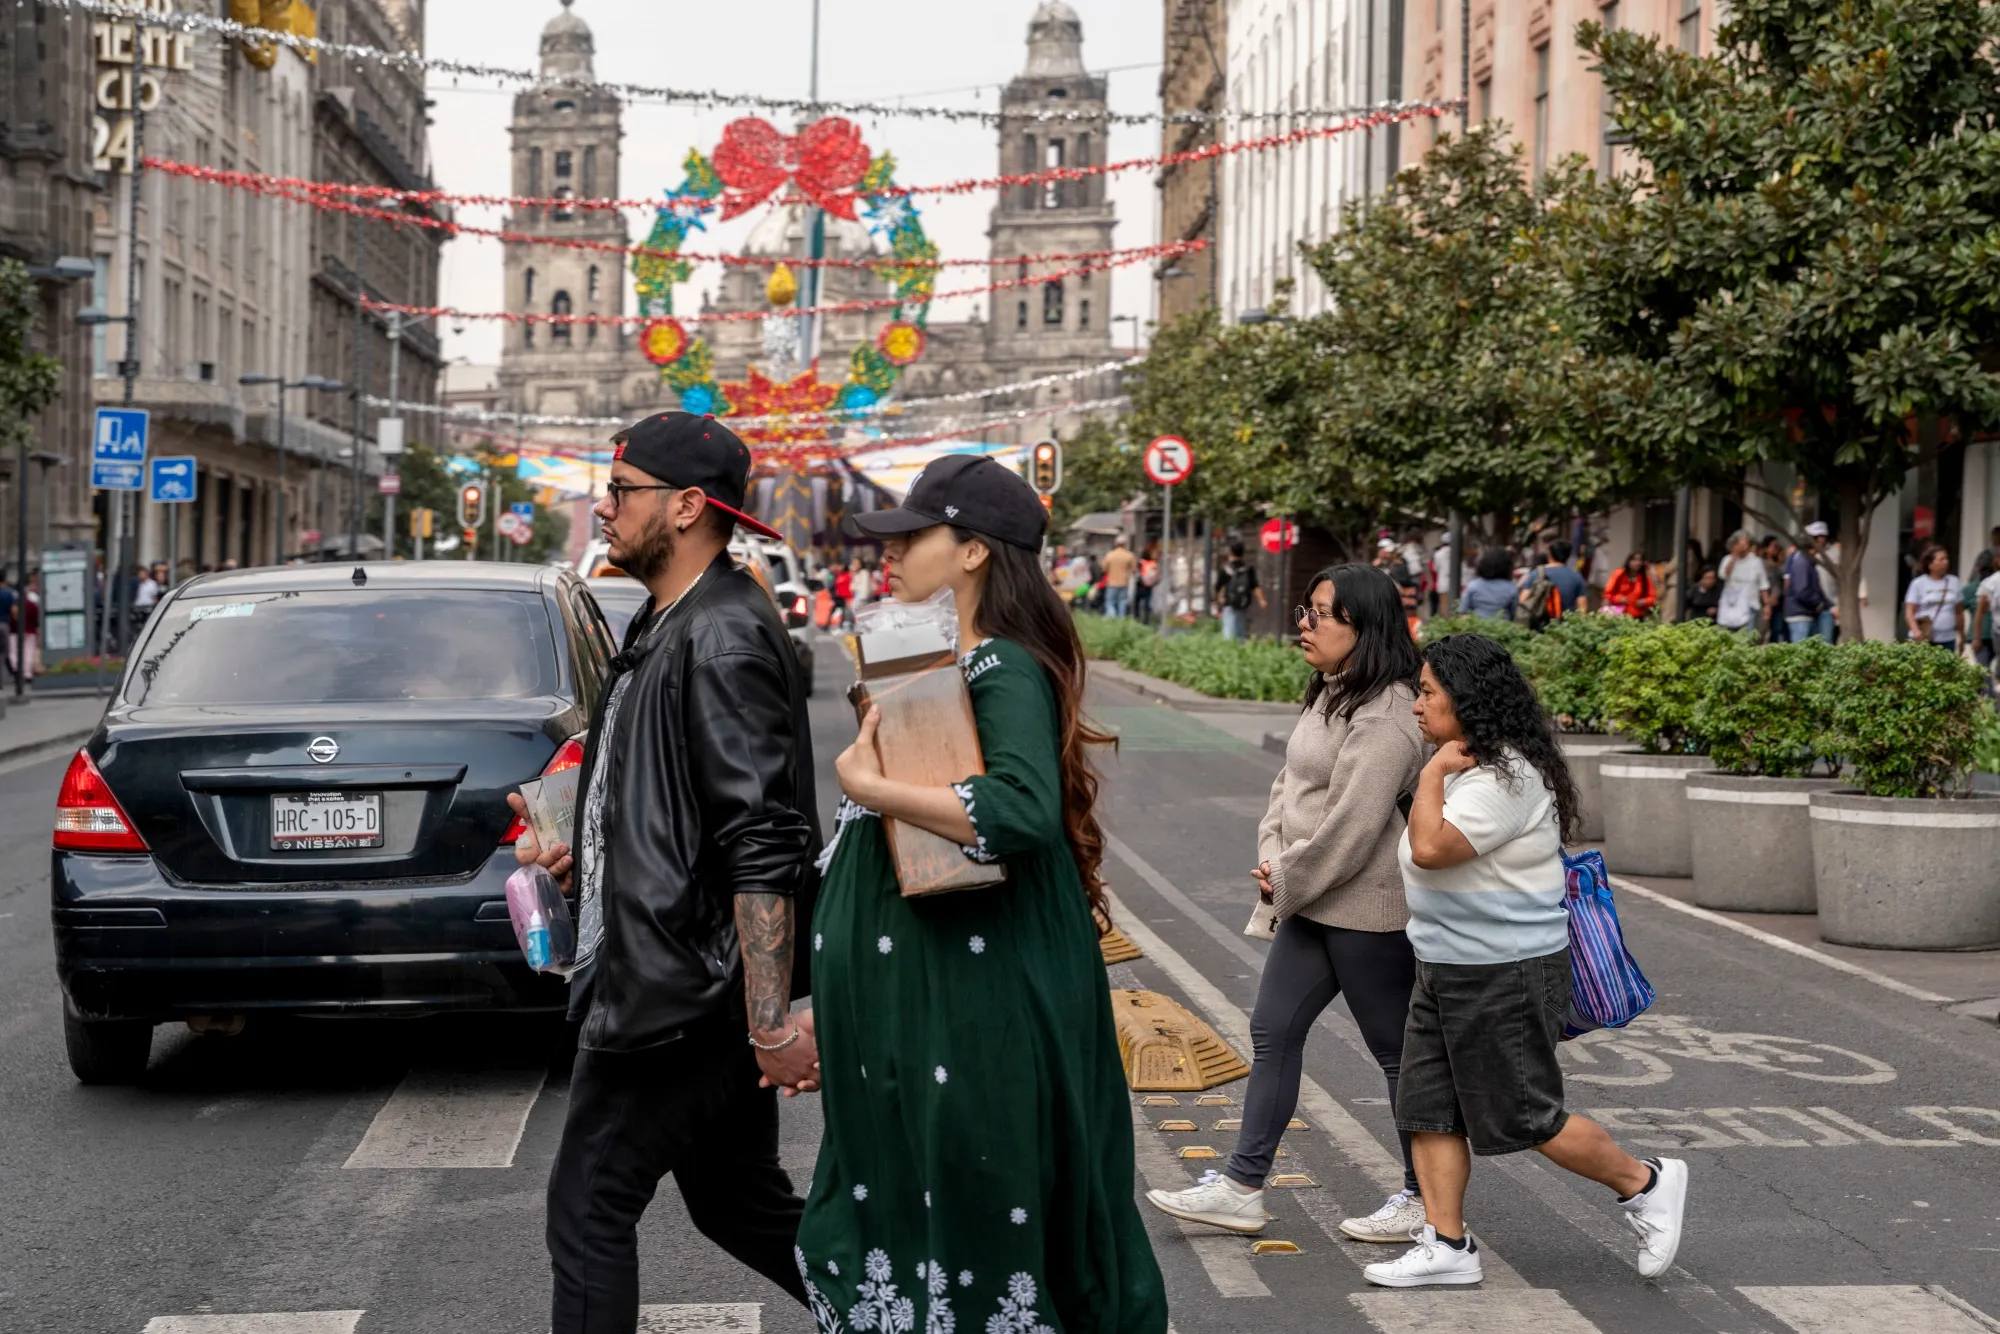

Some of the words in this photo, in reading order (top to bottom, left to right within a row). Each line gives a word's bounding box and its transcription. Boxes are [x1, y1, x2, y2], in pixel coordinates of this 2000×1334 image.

[1160, 446, 1178, 473] E
[276, 807, 376, 832] HRC-105-D
[296, 838, 356, 849] NISSAN
